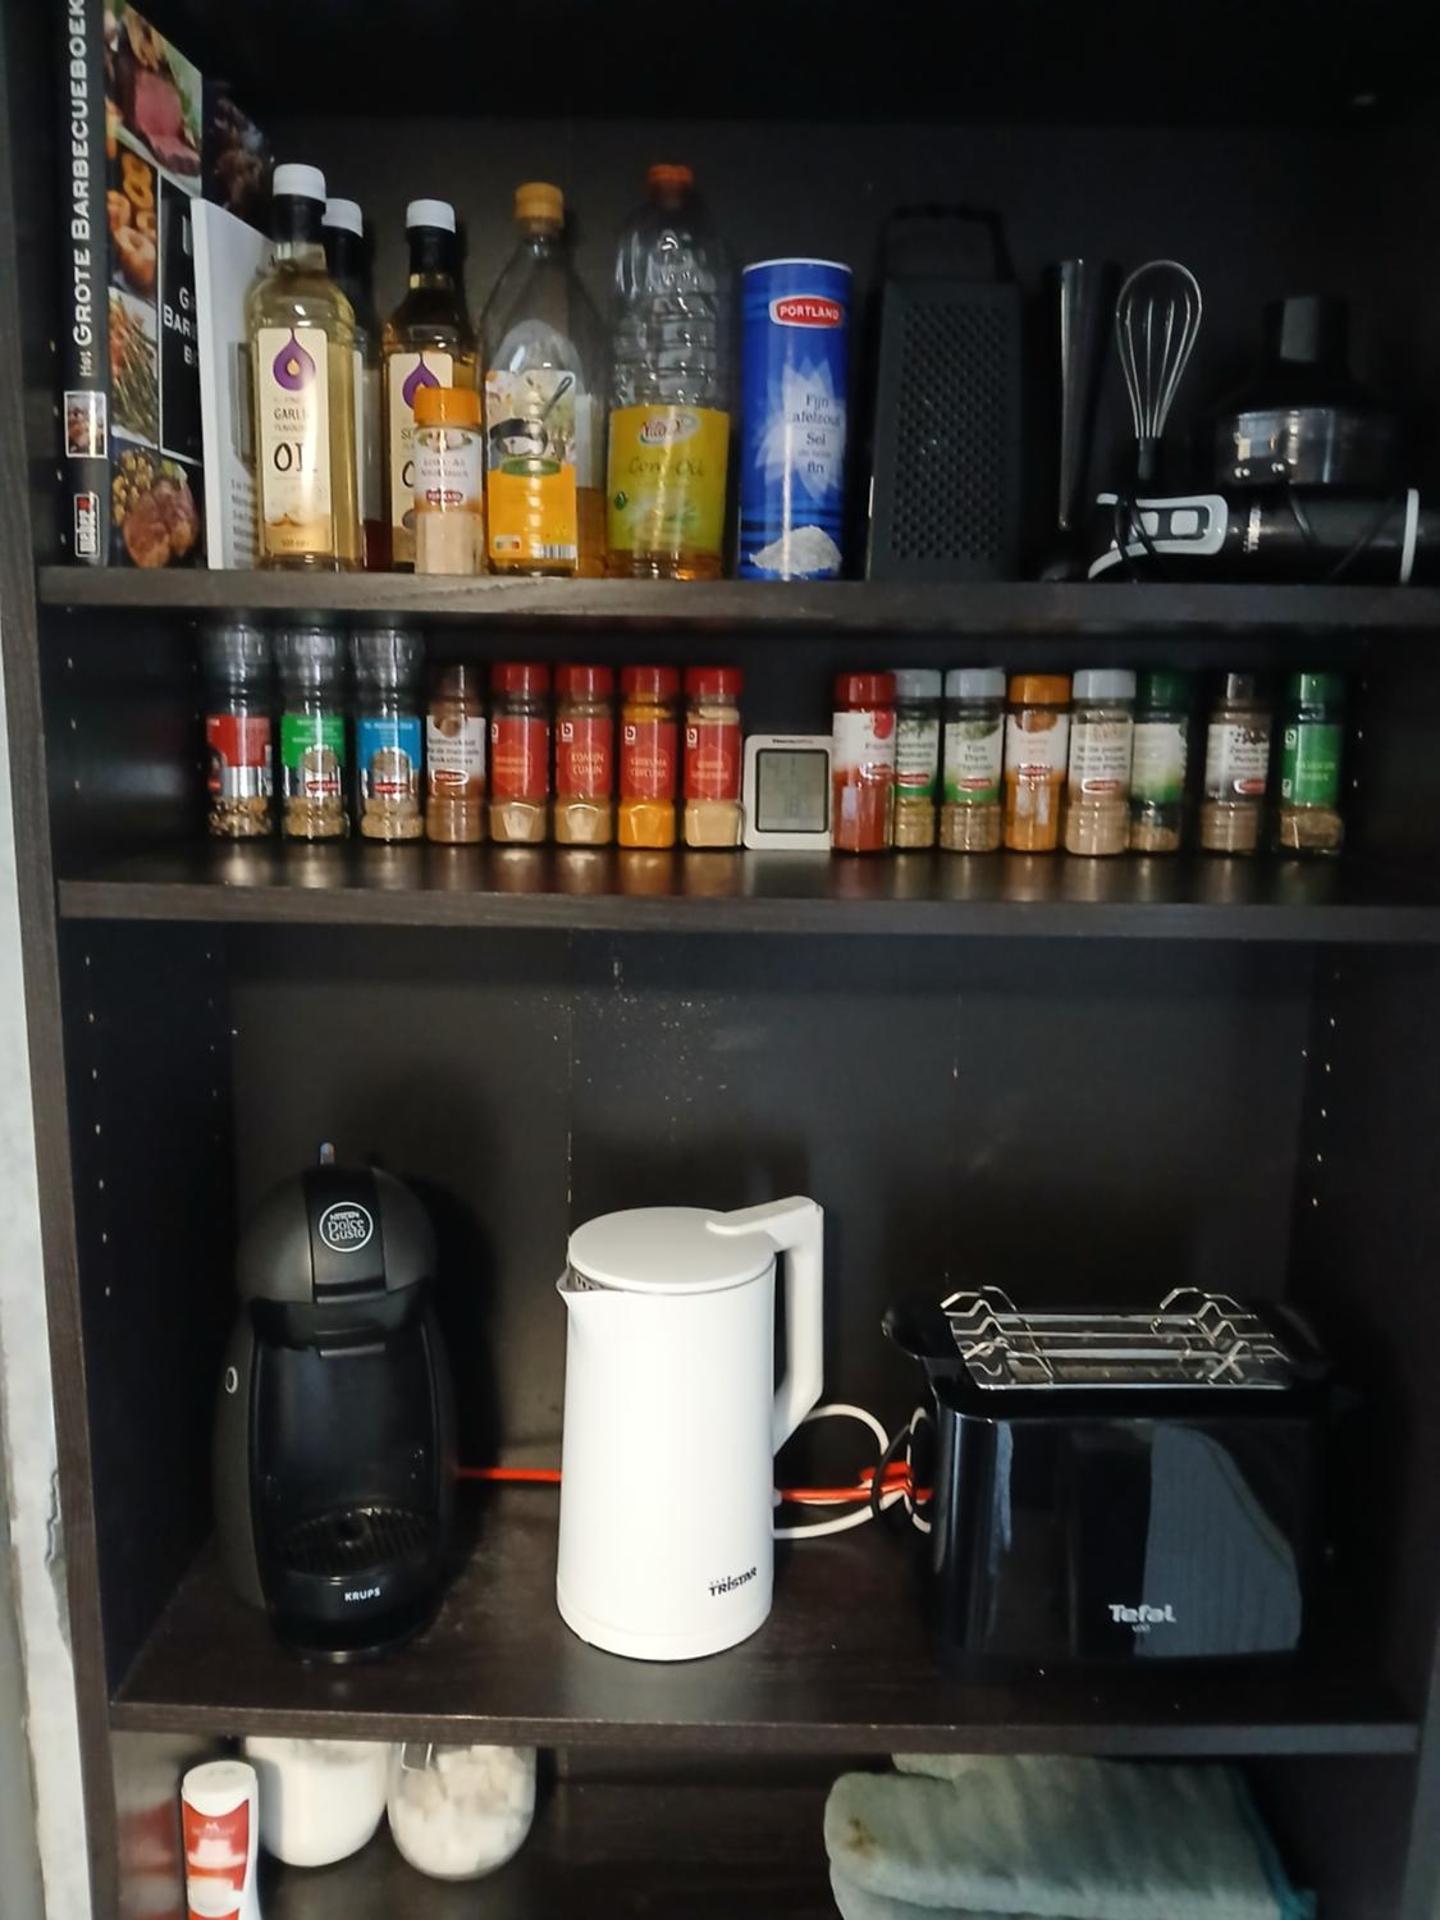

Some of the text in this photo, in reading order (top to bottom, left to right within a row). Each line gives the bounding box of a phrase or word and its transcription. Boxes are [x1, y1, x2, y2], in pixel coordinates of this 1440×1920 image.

[779, 304, 841, 321] PORTLAND
[806, 432, 826, 446] Sel
[807, 461, 825, 474] fin
[708, 1566, 758, 1597] TRISTAR
[343, 1586, 381, 1602] KRUPS
[1107, 1603, 1178, 1623] Tefal
